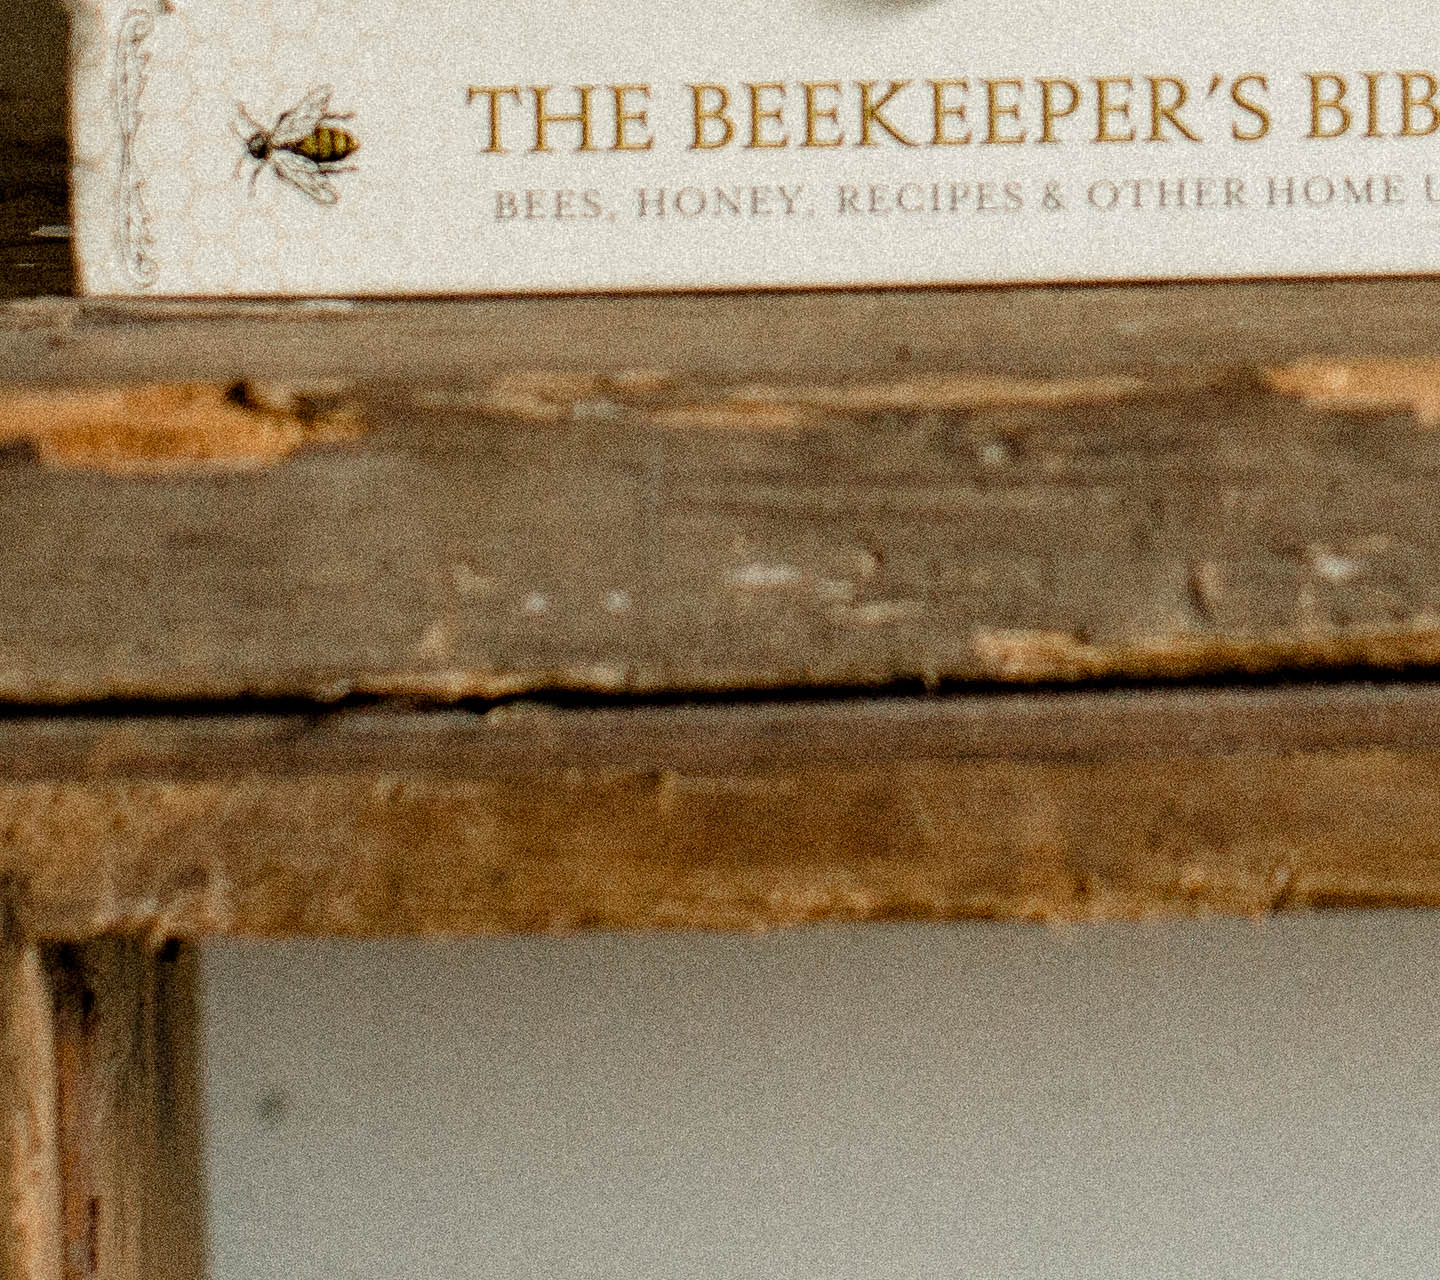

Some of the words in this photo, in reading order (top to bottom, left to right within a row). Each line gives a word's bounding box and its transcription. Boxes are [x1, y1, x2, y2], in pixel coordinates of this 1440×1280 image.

[465, 83, 656, 154] THE
[684, 72, 1272, 151] BEEKEEPER'S
[494, 189, 618, 224] BEES,
[637, 184, 817, 219] HONEY,
[837, 182, 1025, 214] RECIPES
[1041, 182, 1066, 211] &
[1086, 176, 1250, 211] OTHER
[1266, 173, 1404, 209] HOME
